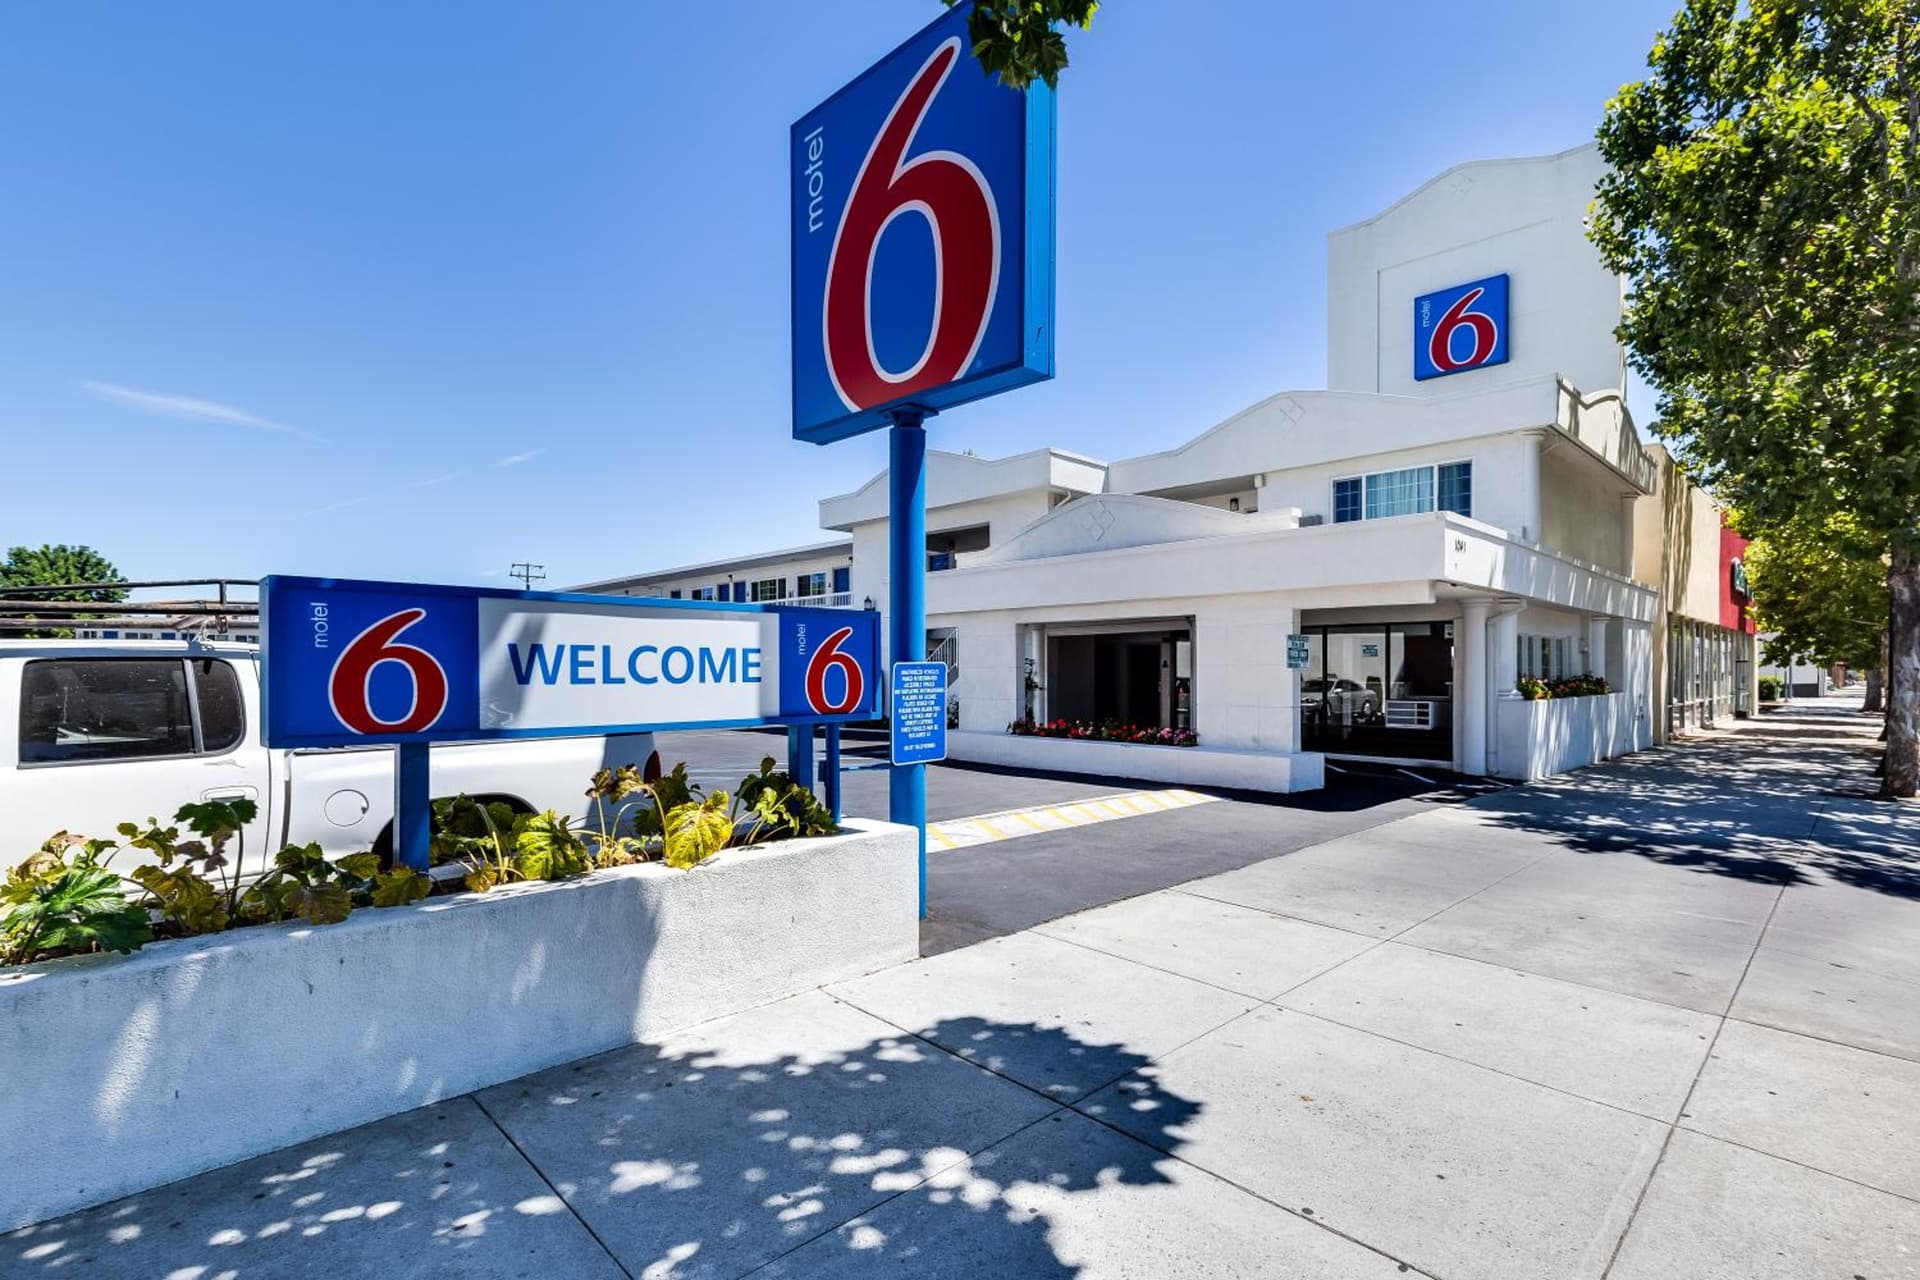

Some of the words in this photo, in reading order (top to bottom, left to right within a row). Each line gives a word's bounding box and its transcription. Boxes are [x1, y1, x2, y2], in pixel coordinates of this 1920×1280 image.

[804, 126, 824, 233] motel
[822, 35, 1001, 412] 6
[1421, 300, 1431, 328] motel
[1428, 287, 1498, 372] 6
[309, 602, 329, 648] motel
[328, 607, 449, 735] 6
[507, 643, 762, 685] WELCOME
[797, 623, 806, 656] motel
[805, 626, 864, 715] 6
